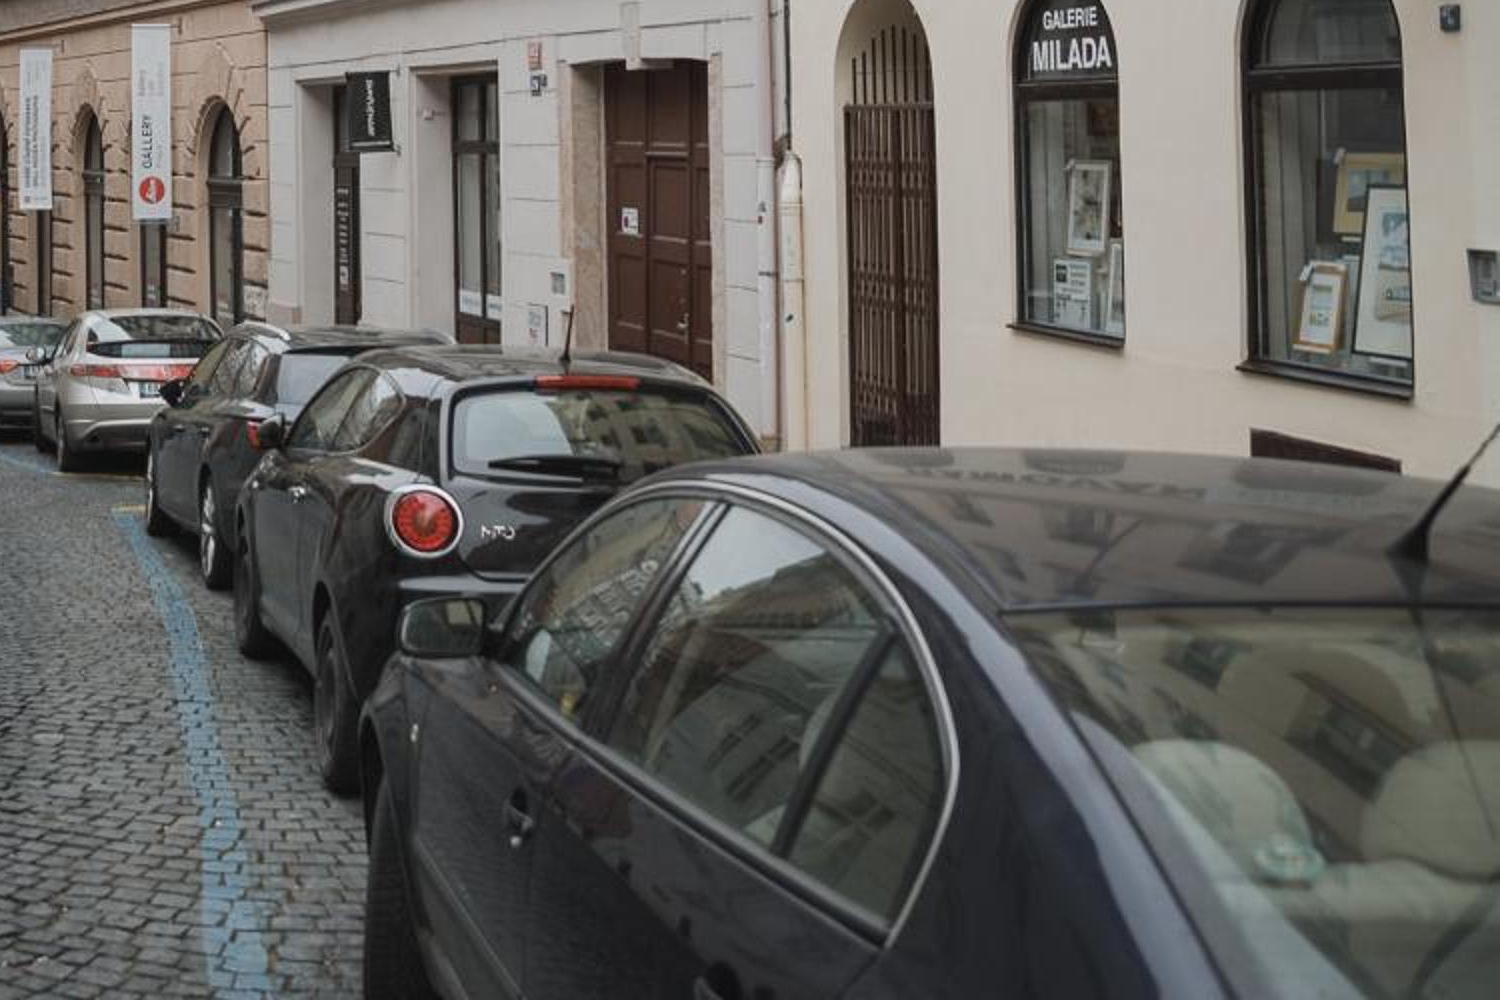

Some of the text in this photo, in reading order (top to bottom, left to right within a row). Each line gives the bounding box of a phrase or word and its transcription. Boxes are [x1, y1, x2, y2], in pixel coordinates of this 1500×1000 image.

[1043, 6, 1098, 31] GALERIE
[1032, 36, 1112, 72] MILADA
[141, 114, 153, 169] GALLERY
